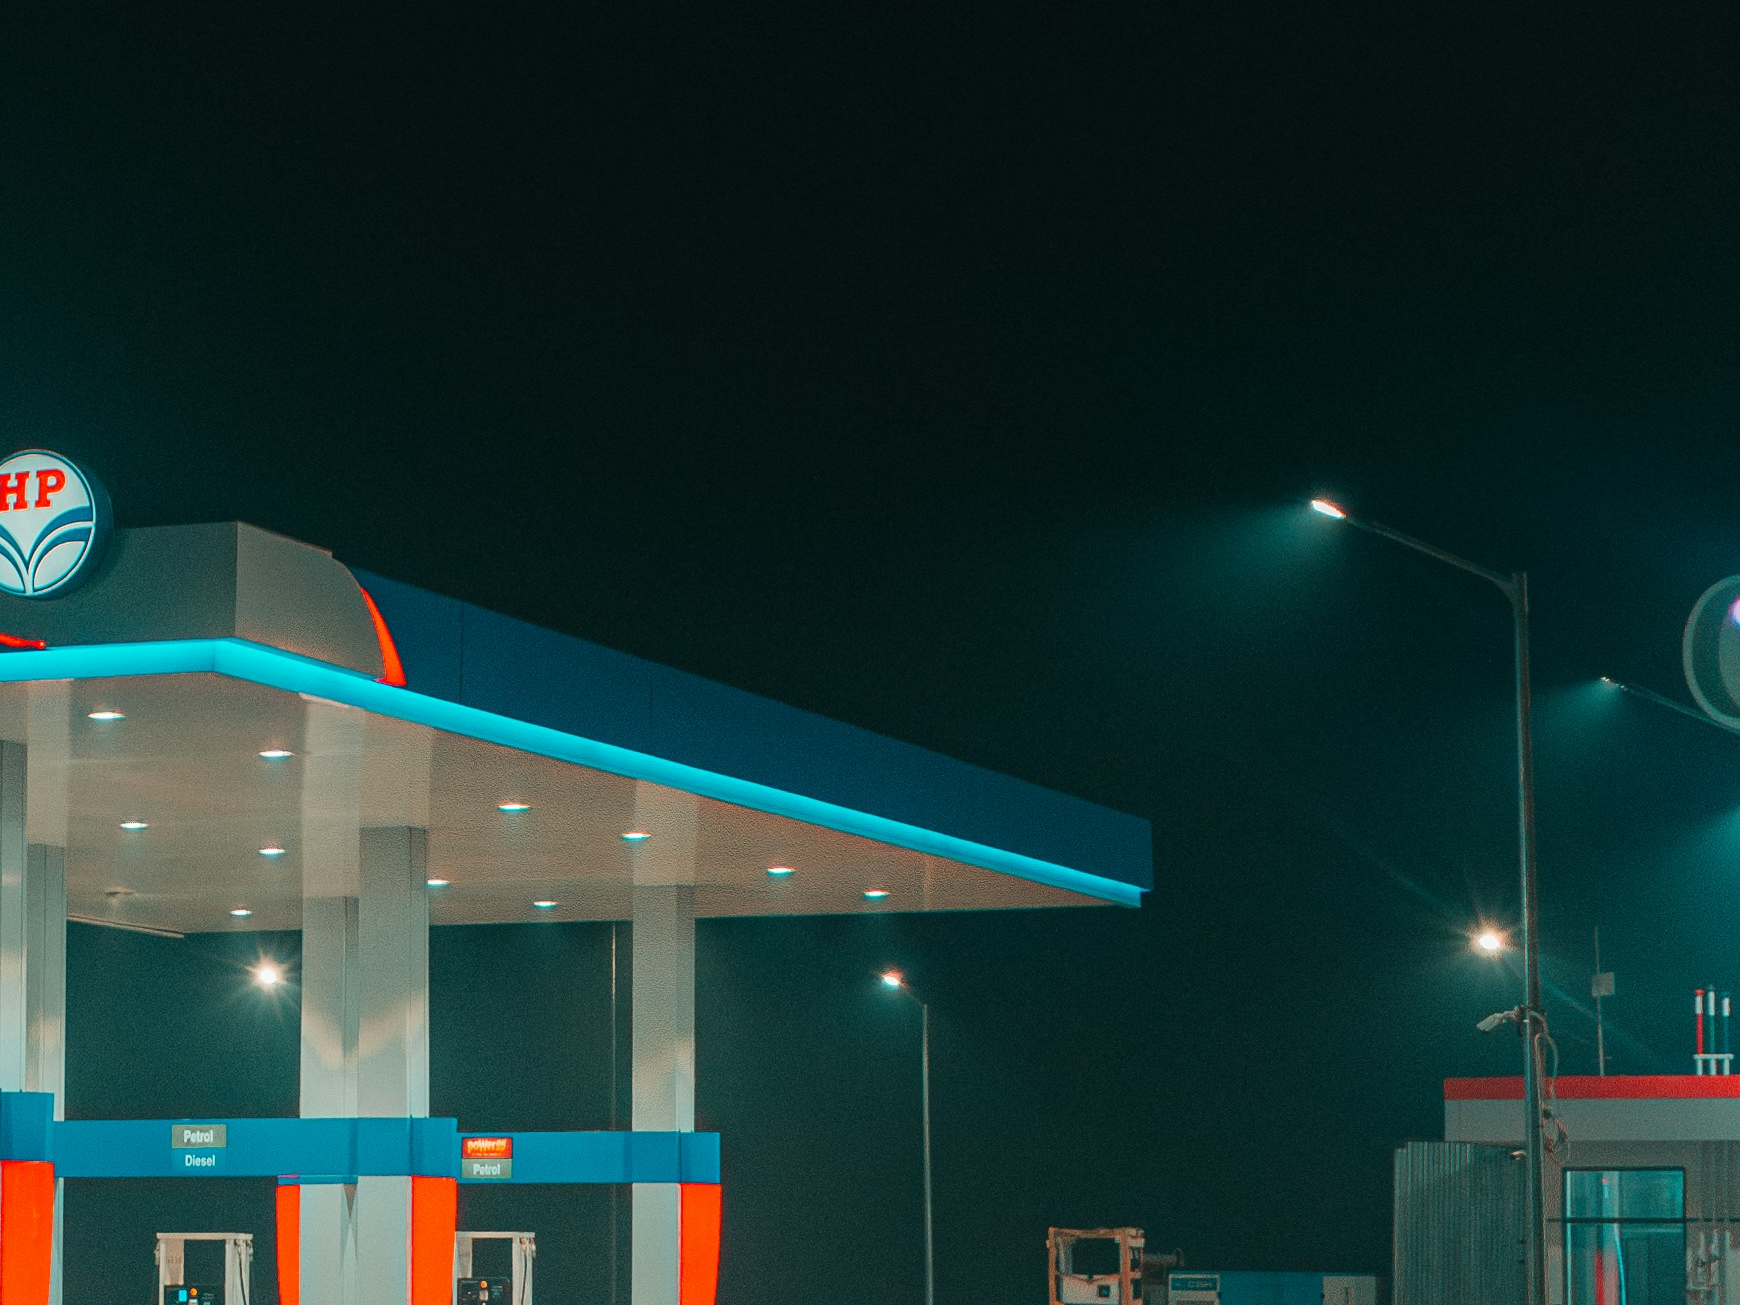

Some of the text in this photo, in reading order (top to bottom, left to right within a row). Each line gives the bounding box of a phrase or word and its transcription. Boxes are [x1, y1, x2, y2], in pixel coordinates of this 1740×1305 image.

[183, 1129, 214, 1143] Petrol
[184, 1154, 216, 1167] Diesel
[472, 1163, 501, 1176] Petrol
